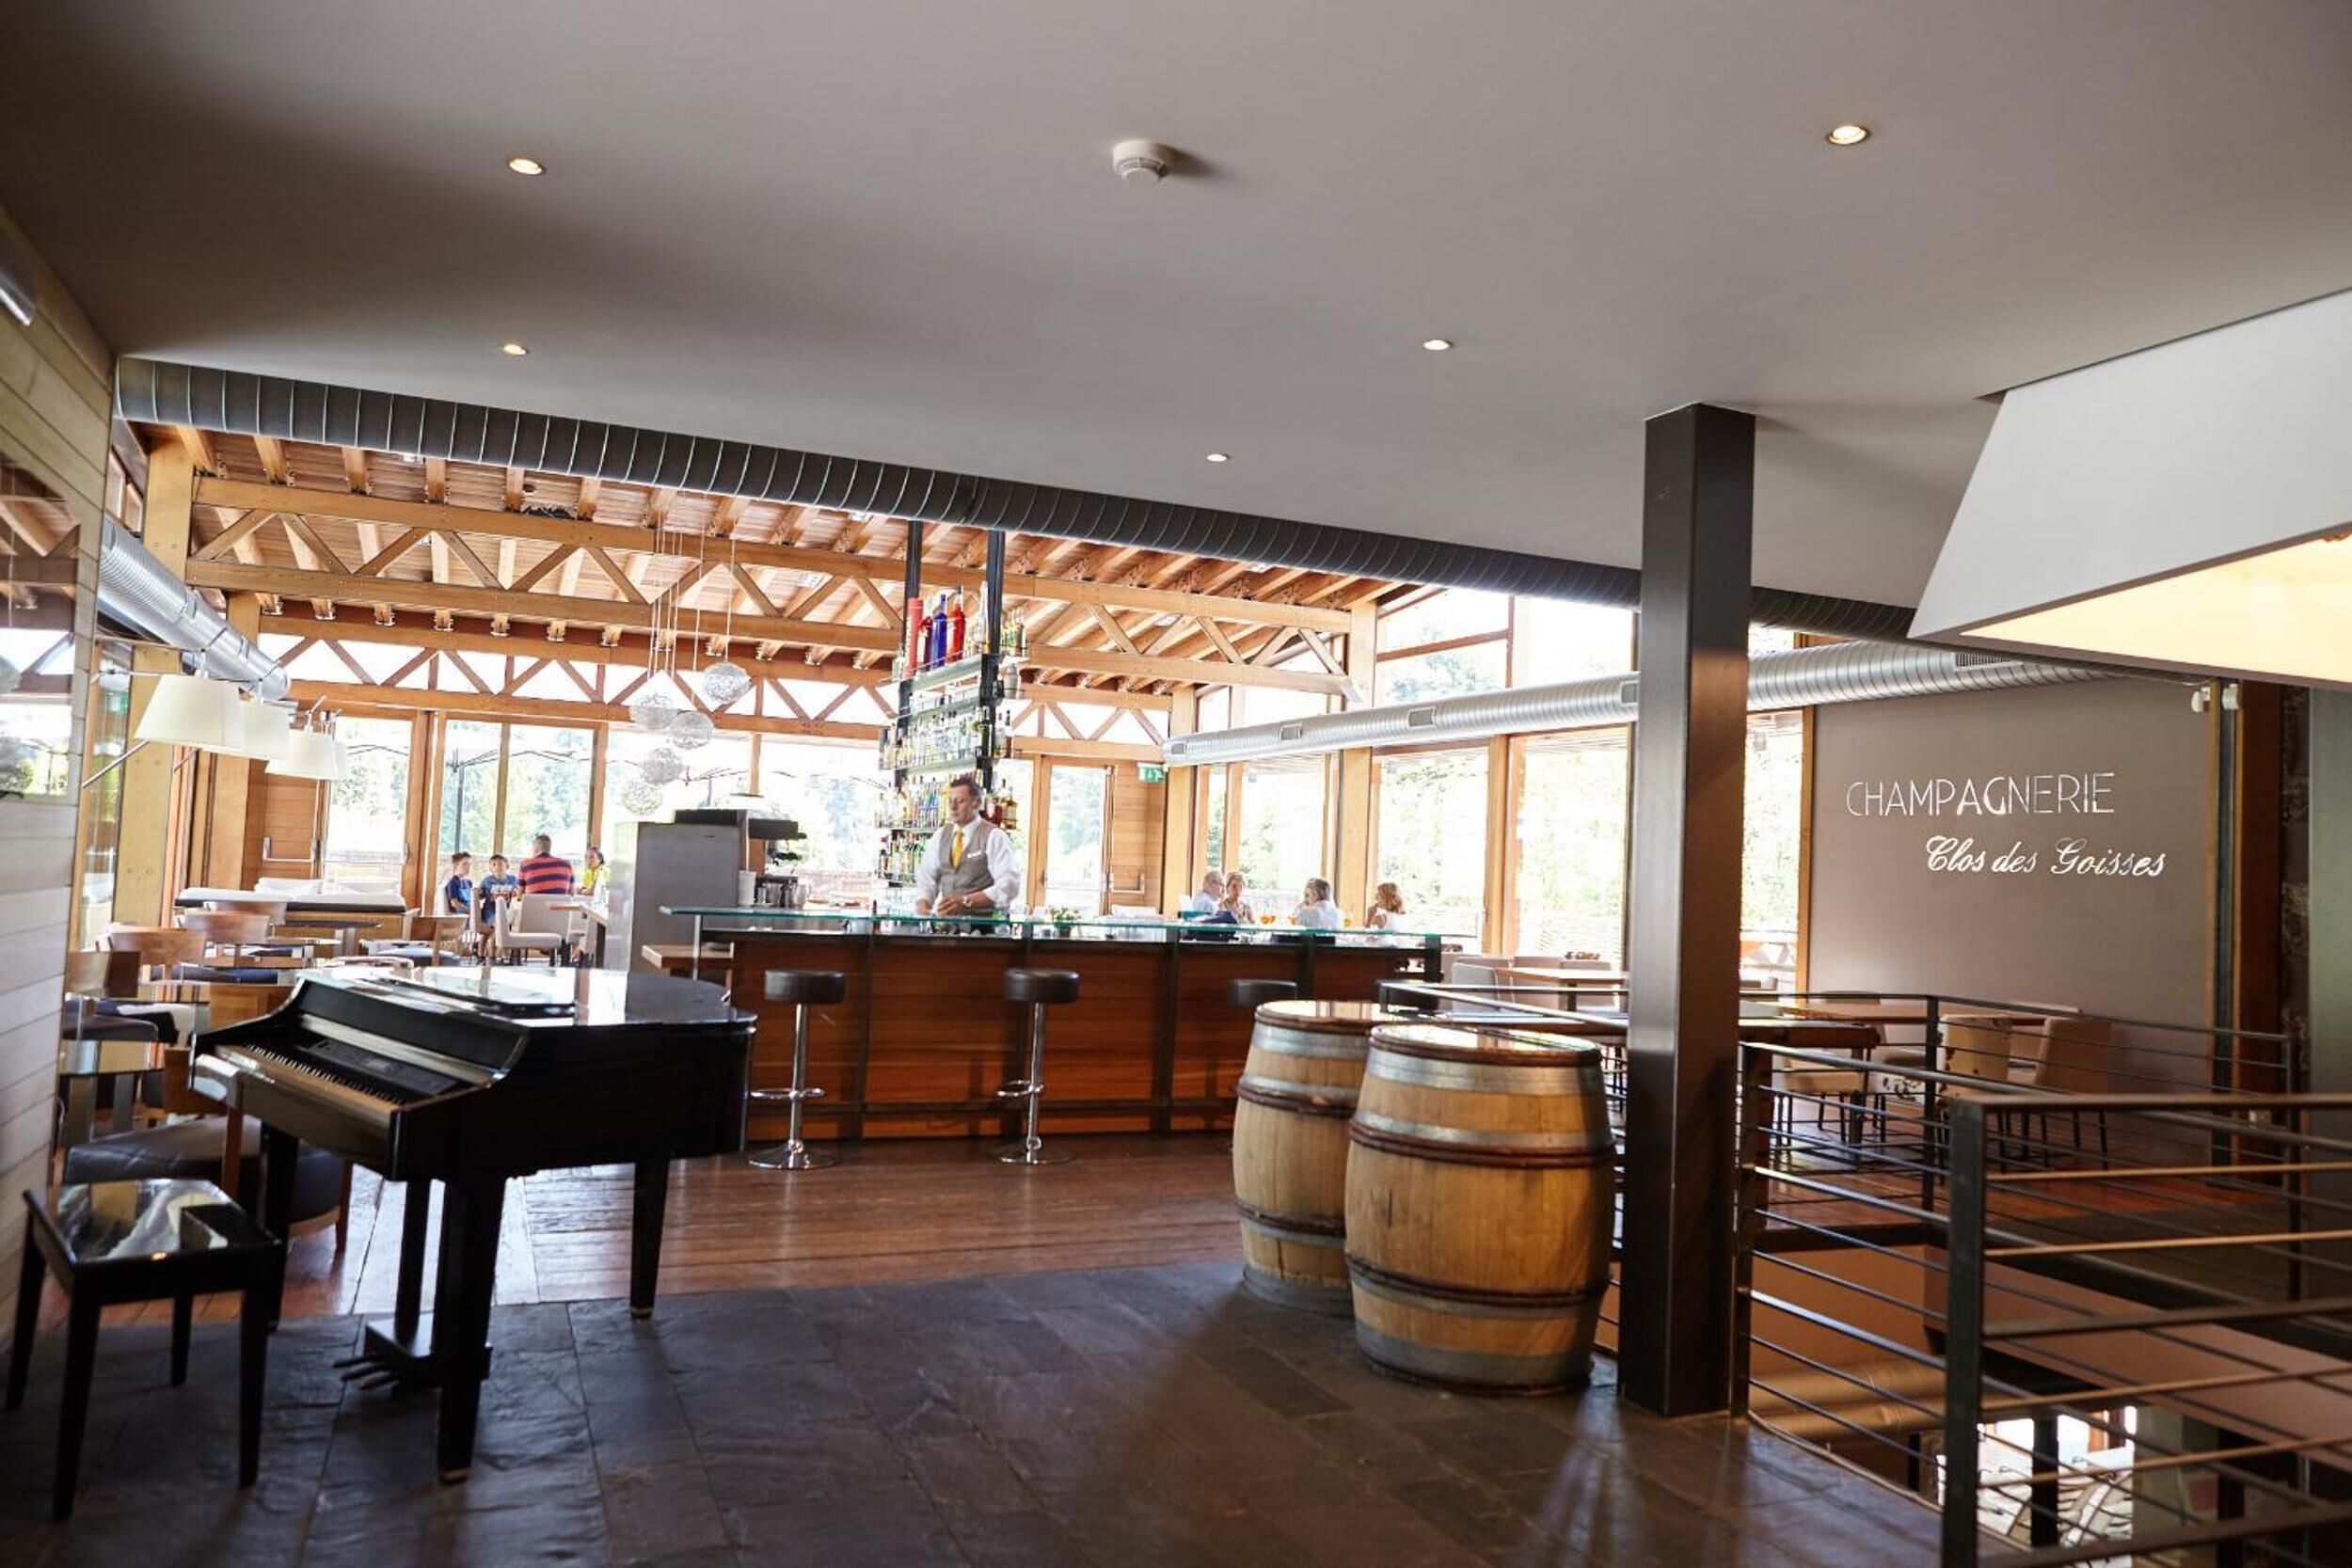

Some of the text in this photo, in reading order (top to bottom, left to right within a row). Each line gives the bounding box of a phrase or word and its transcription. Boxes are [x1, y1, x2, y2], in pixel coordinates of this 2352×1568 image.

[1846, 772, 2114, 816] CHAMPAGNERIE
[1926, 835, 2167, 877] Clos des Goisses
